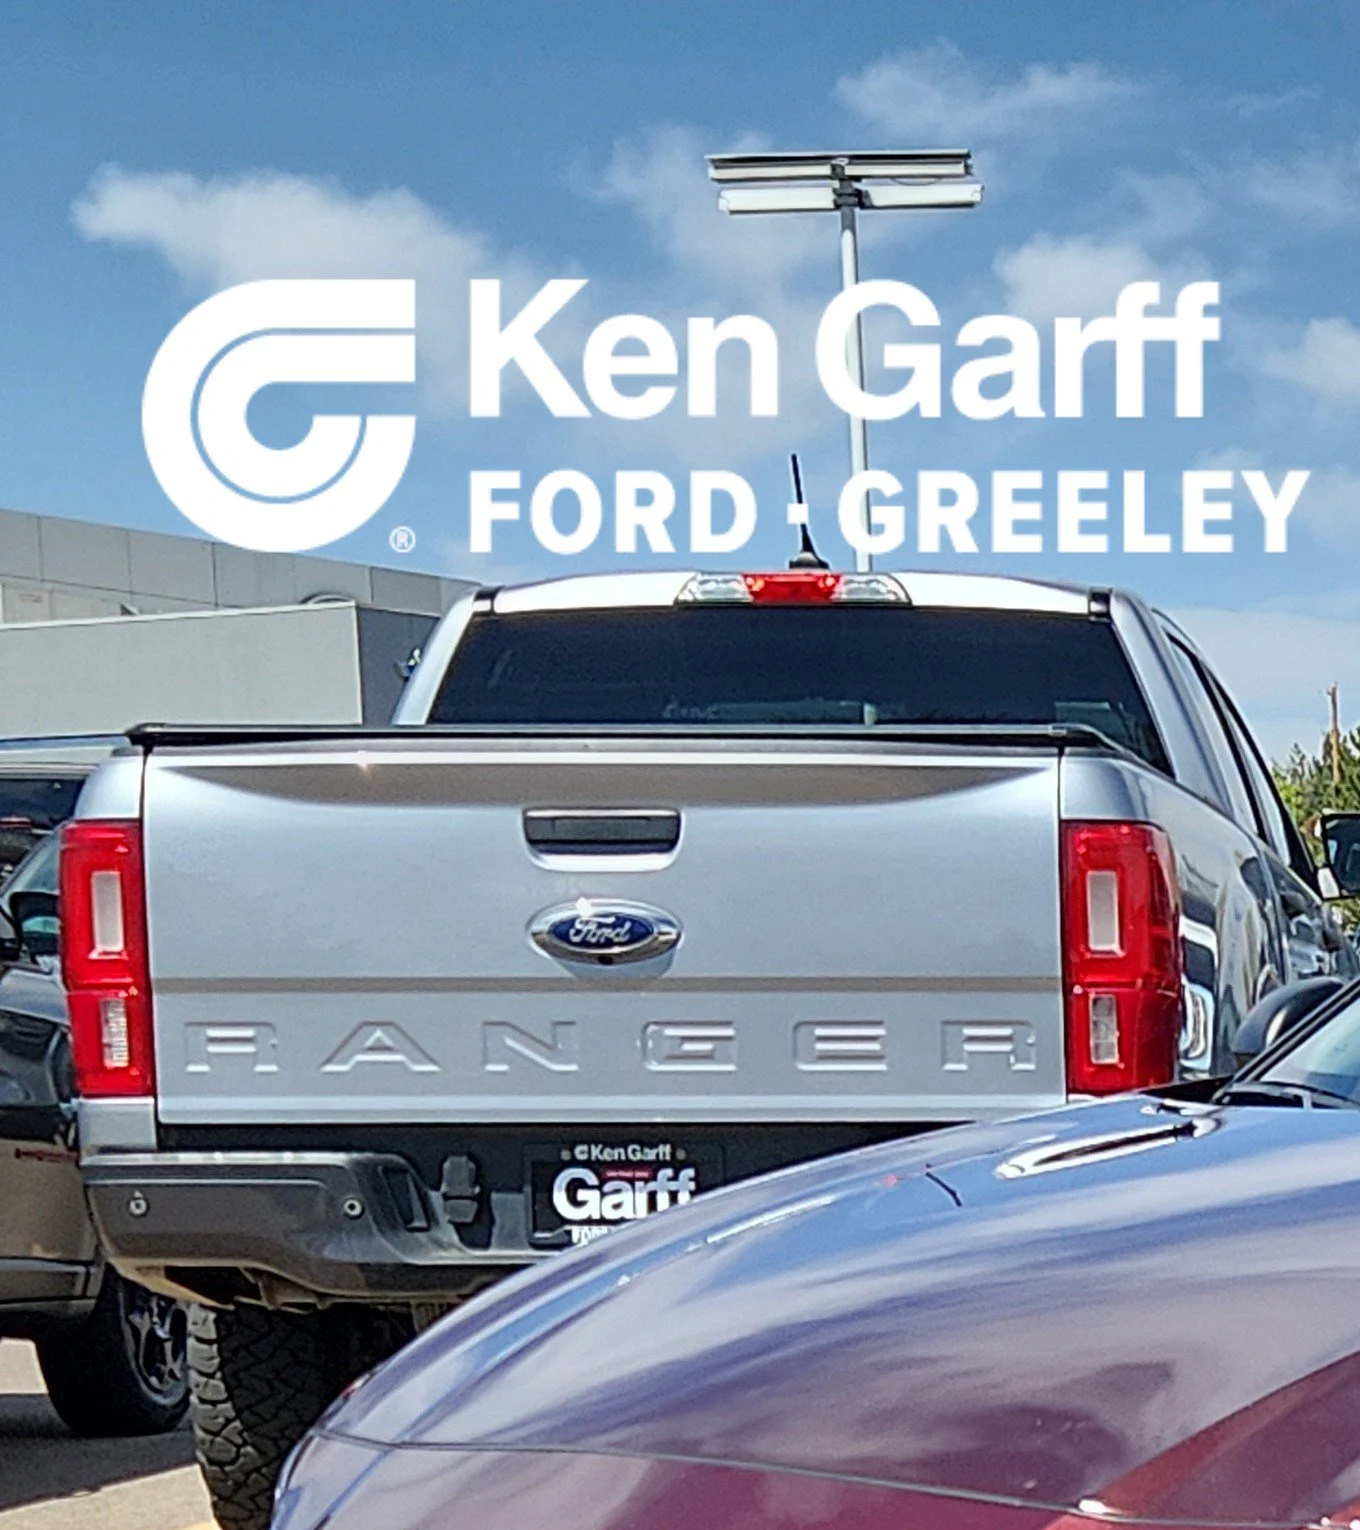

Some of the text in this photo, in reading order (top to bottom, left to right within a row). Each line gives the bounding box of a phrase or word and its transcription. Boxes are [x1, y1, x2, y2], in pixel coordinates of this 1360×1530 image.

[568, 915, 632, 943] Ford
[183, 1020, 1037, 1073] RANGER
[590, 1143, 672, 1161] Ken Garff
[552, 1166, 697, 1221] Garff
